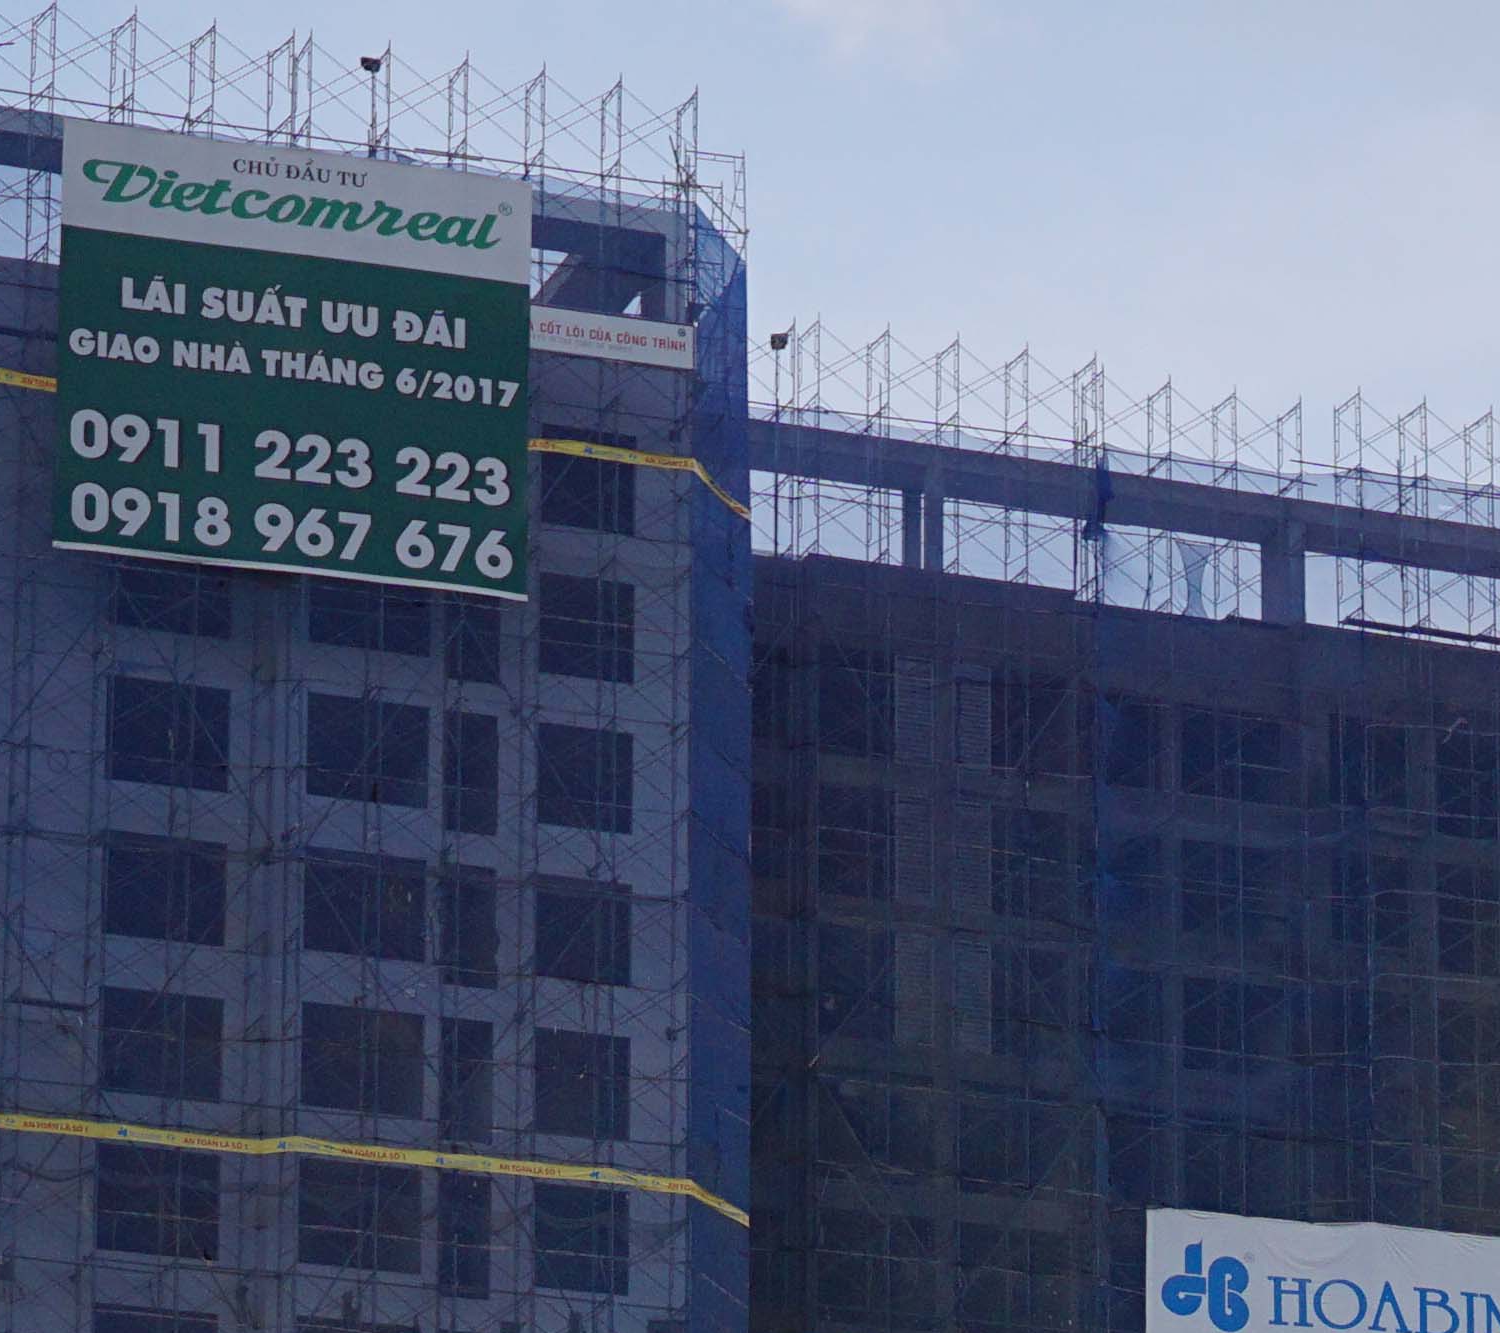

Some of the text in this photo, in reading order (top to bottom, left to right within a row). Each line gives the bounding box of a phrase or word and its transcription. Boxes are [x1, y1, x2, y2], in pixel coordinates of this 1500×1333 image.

[82, 159, 500, 249] Vietcomreal
[232, 155, 368, 188] CHỦ ĐẦU TƯ
[121, 275, 467, 350] LÃI SUẤT ƯU ĐÃI
[68, 328, 520, 408] GIAO NHÀ THÁNG 6/2017
[69, 408, 512, 508] 0911 223 223
[70, 481, 514, 581] 0918 967 676
